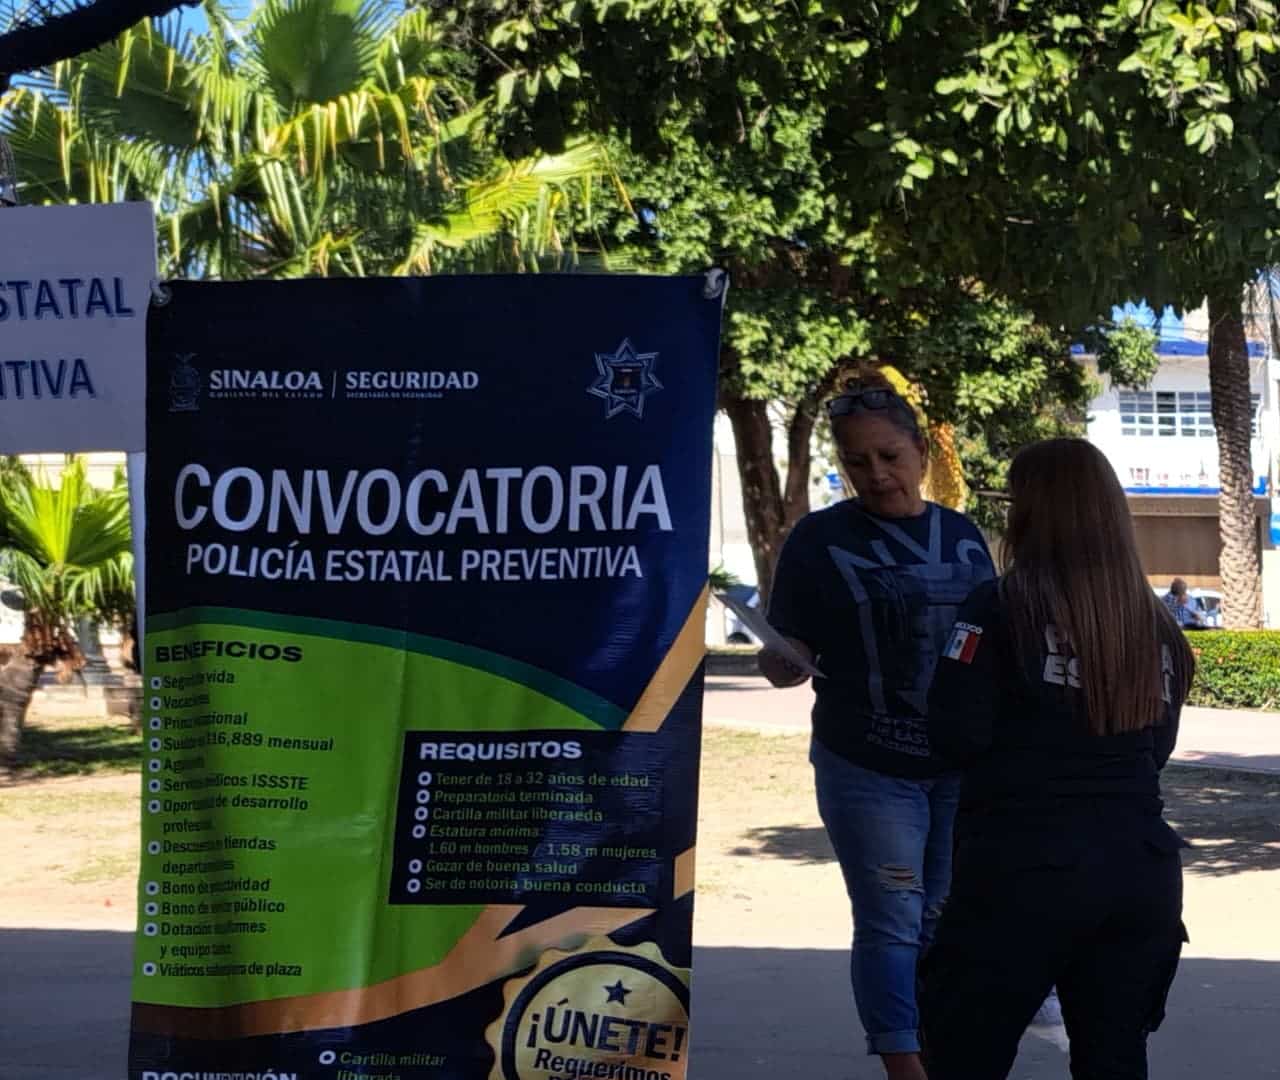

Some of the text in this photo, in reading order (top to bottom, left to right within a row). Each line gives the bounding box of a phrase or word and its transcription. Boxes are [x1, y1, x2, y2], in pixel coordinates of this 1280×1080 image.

[0, 358, 97, 400] TIVA
[209, 369, 480, 391] SINALOA SEGURIDAD
[174, 463, 673, 536] CONVOCATORIA
[187, 540, 643, 582] POLICÍA ESTATAL PREVENTIVA
[155, 640, 303, 663] BENEFICIOS
[268, 736, 335, 751] mensual
[420, 740, 583, 762] REQUISITOS
[611, 774, 650, 788] edad
[232, 794, 309, 811] desarrollo
[434, 790, 516, 805] Preparatoria
[547, 842, 580, 857] 1.58
[523, 878, 647, 894] buena conducta
[526, 997, 687, 1062] ¡ÚNETE!
